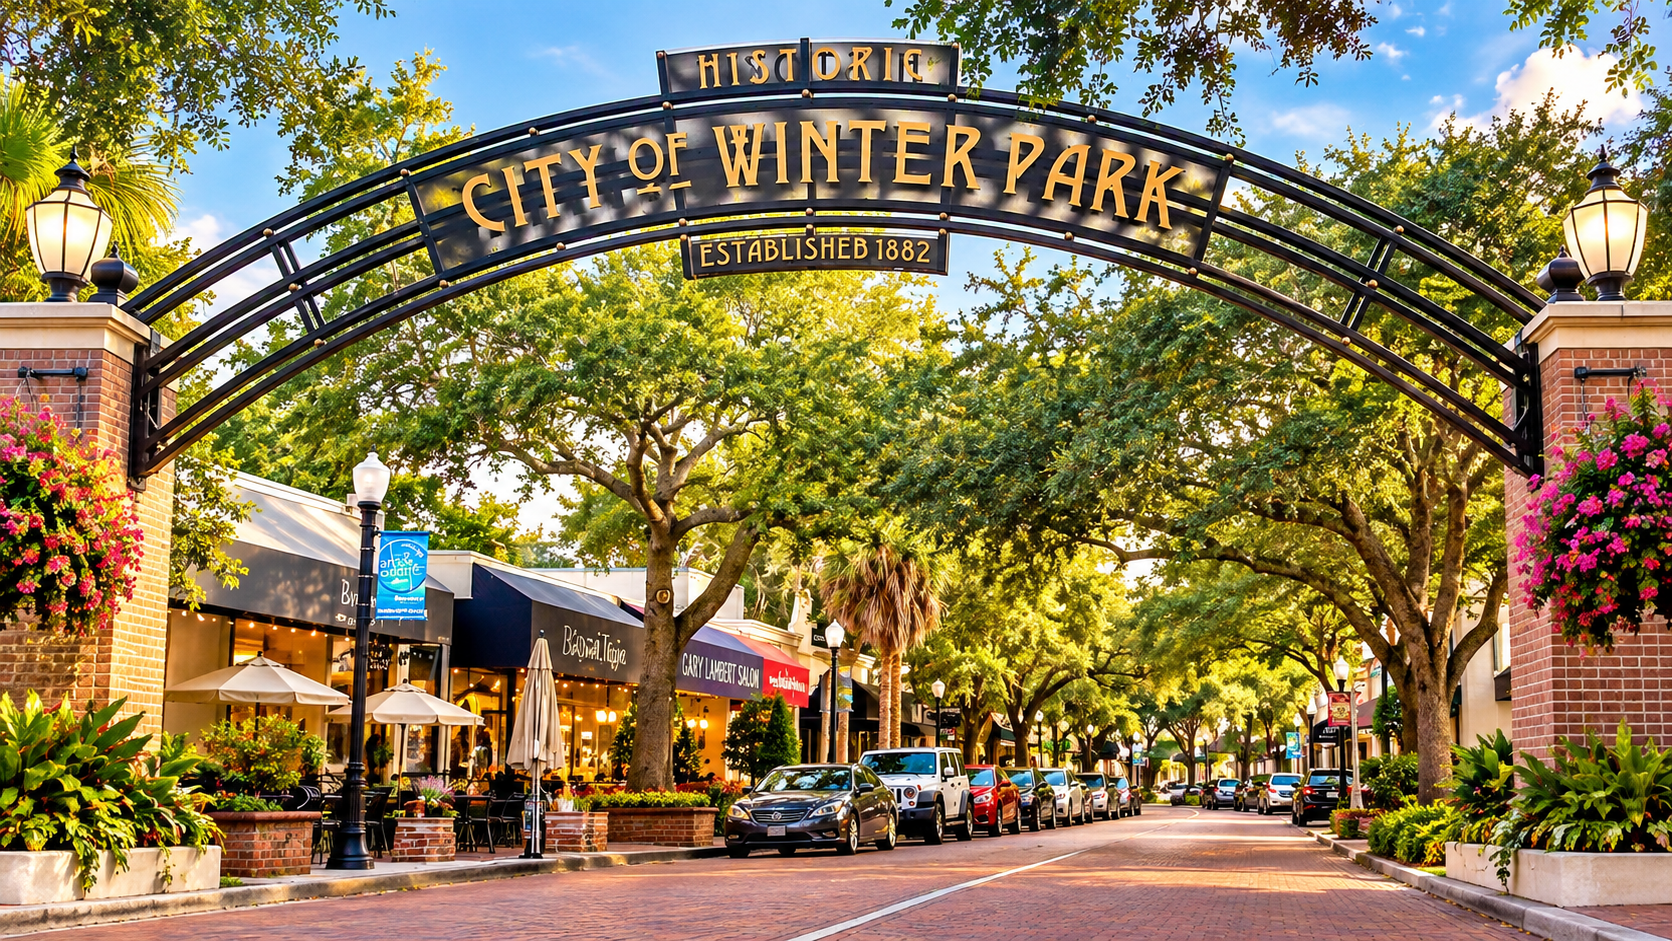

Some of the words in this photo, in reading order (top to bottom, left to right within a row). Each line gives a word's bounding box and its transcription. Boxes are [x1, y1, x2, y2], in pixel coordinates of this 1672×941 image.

[697, 47, 923, 89] HISTORIC
[461, 144, 602, 232] CITY
[628, 131, 690, 191] OF
[712, 120, 981, 190] WINTER
[1003, 132, 1185, 230] PARK
[875, 238, 931, 263] 1882
[682, 652, 704, 679] GARY
[705, 656, 737, 685] LAMBERT
[737, 664, 760, 689] SALON
